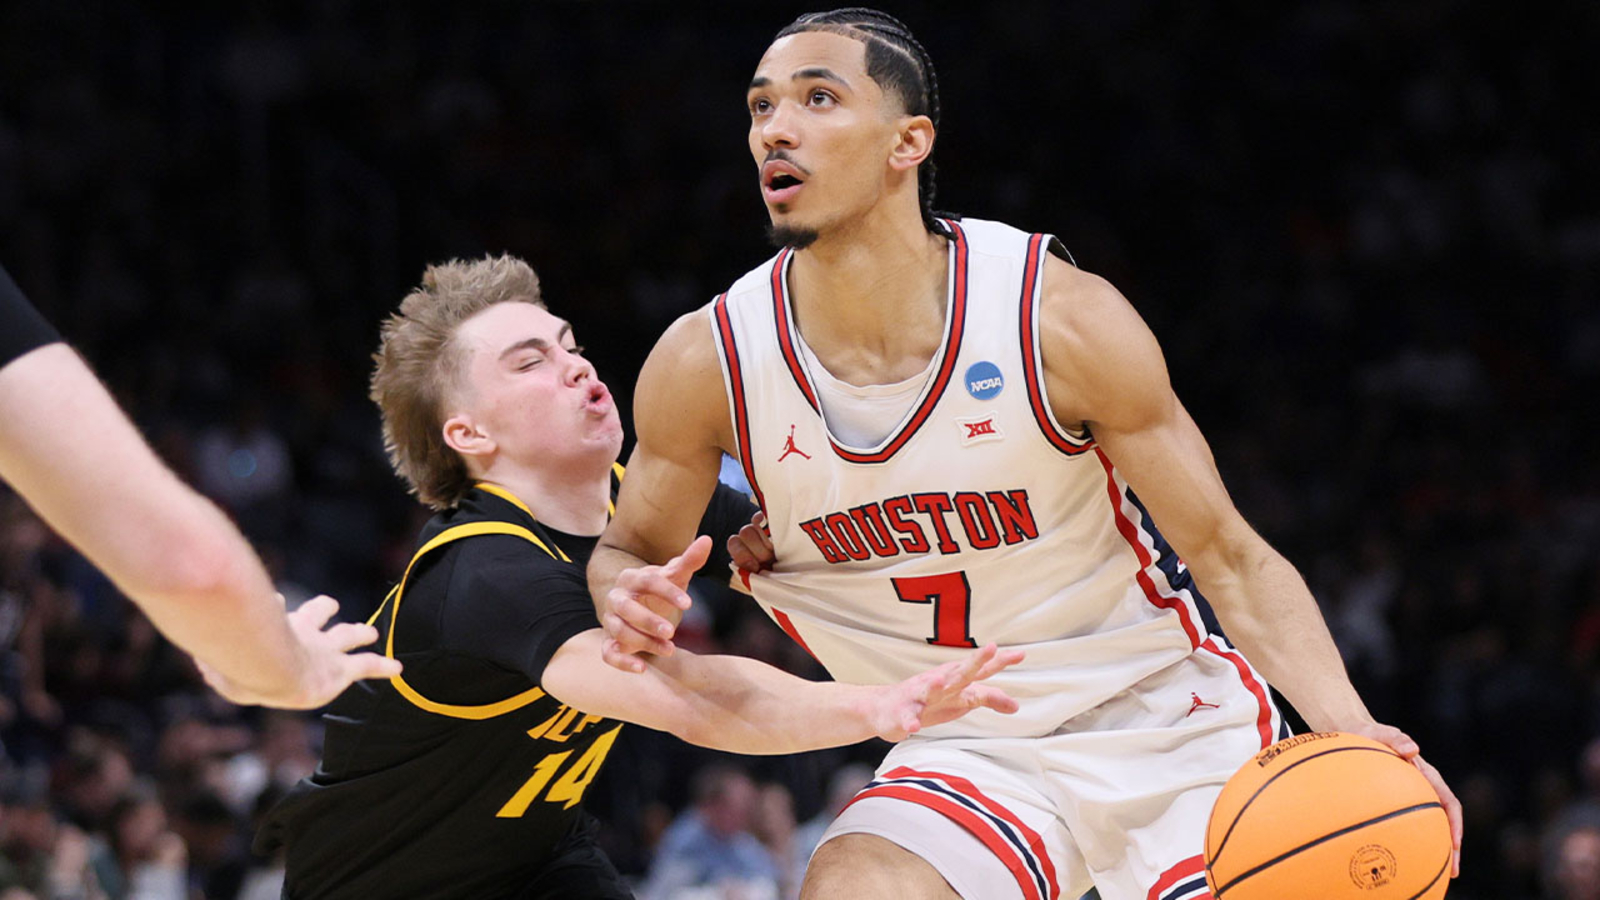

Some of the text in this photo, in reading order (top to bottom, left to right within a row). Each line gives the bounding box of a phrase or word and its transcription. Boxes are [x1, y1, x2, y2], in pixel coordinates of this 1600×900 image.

[970, 377, 1003, 393] NCAA
[964, 418, 996, 438] XII
[799, 489, 1040, 564] HOUSTON
[890, 570, 979, 648] 7
[495, 722, 625, 818] 14
